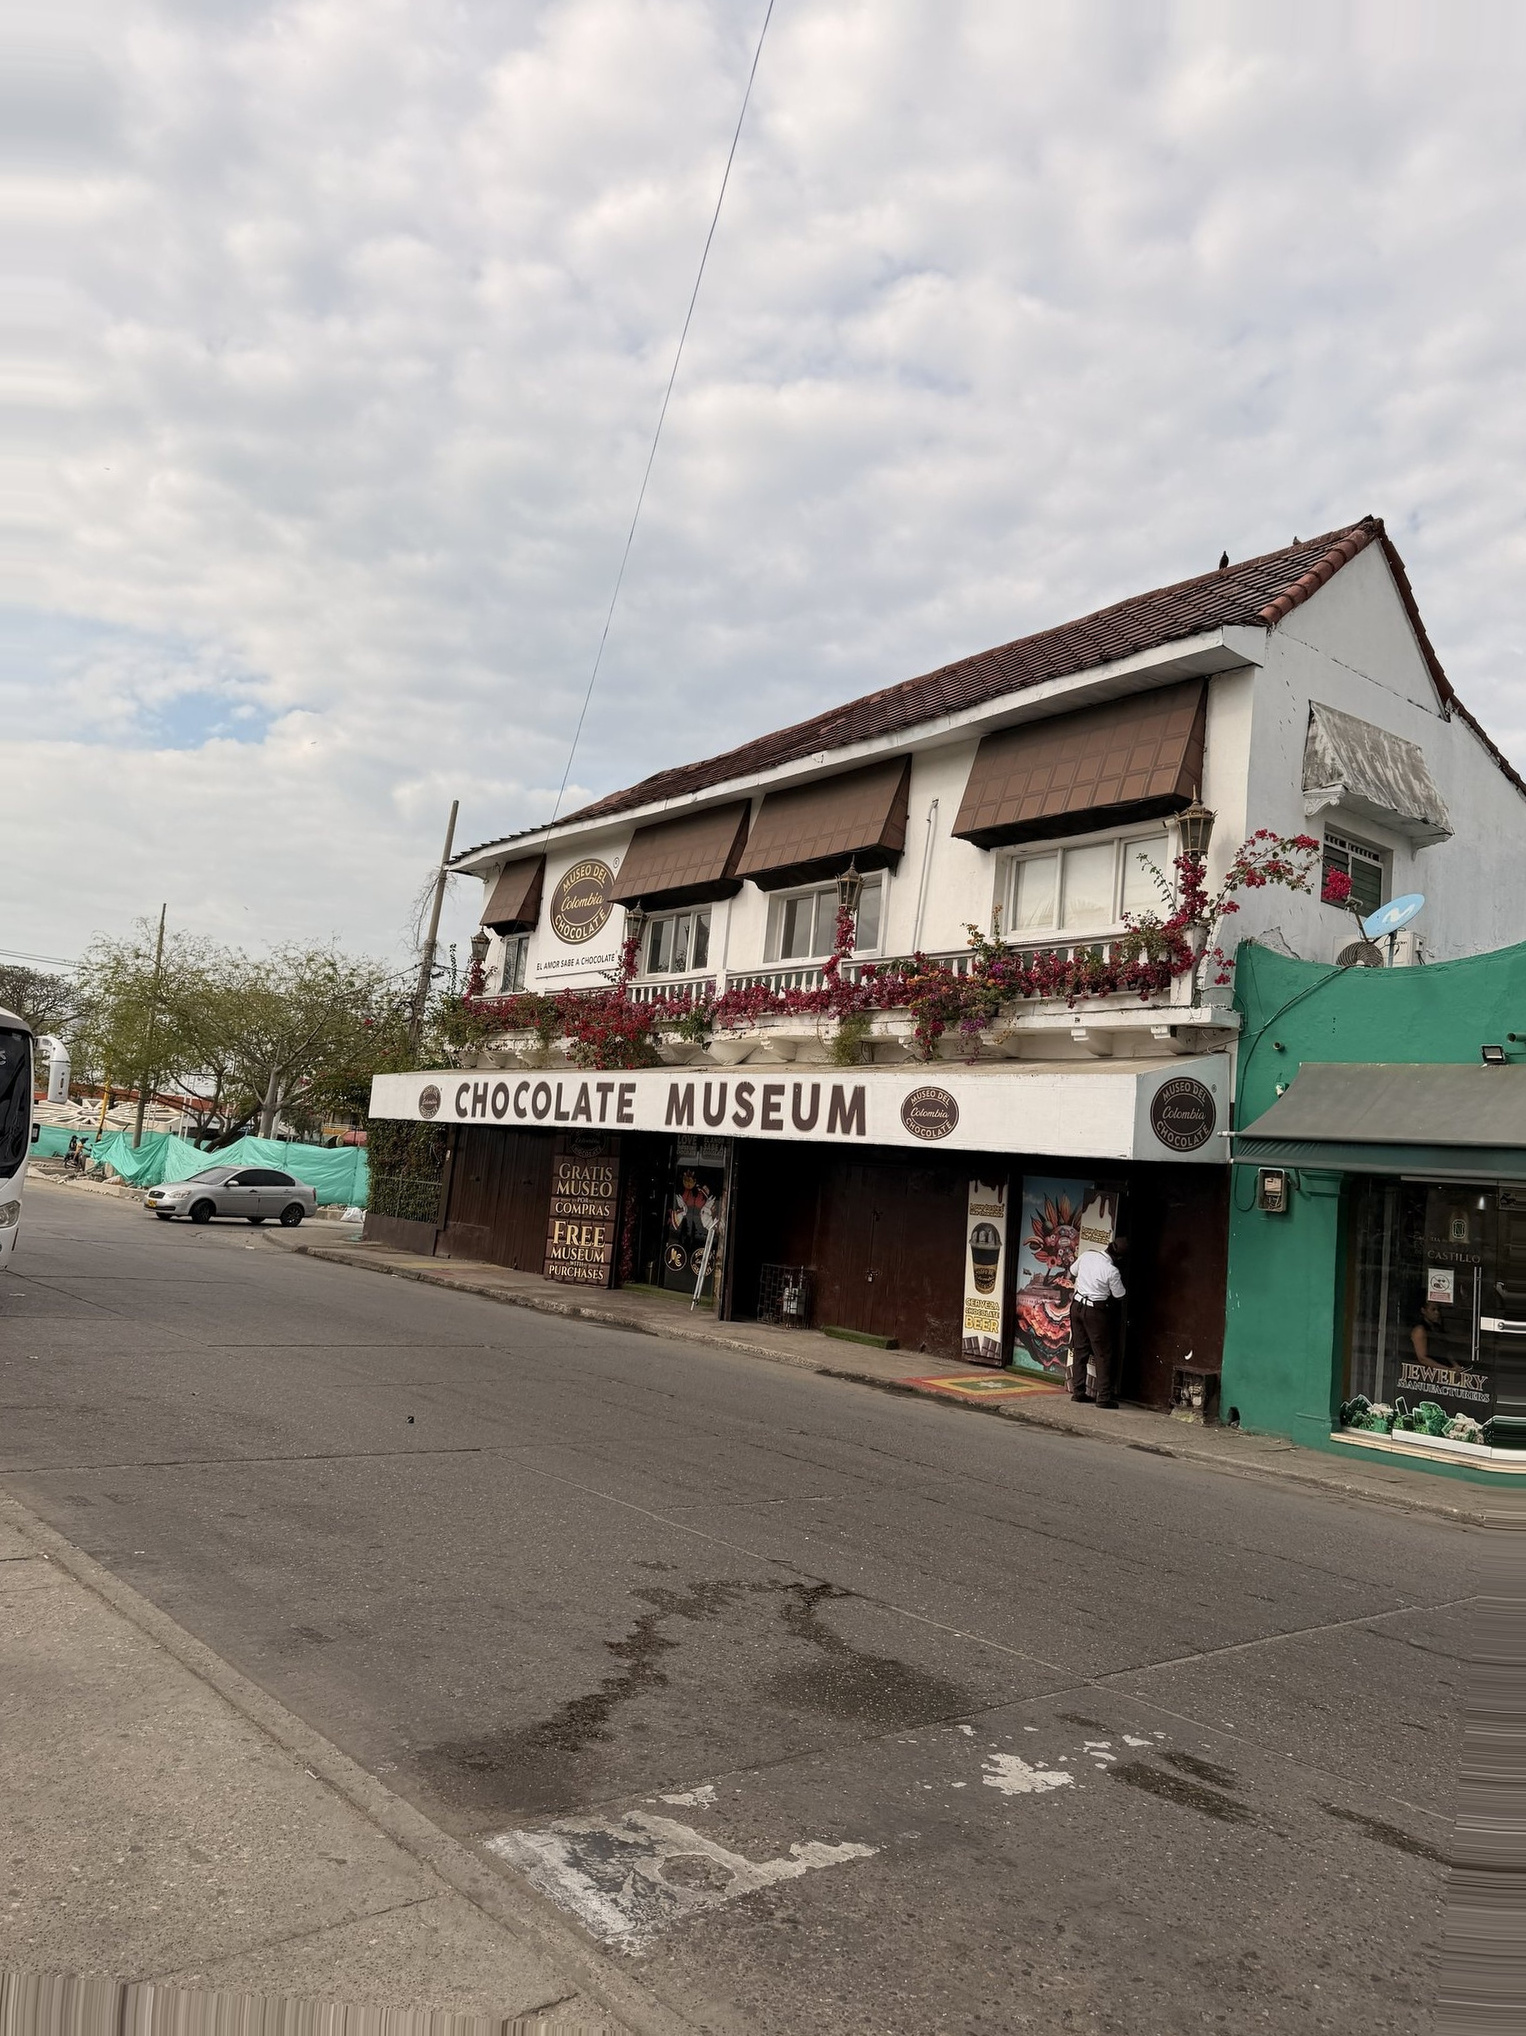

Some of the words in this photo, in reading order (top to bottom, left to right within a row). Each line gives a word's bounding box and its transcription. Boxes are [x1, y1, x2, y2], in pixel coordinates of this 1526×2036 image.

[563, 864, 592, 892] MUSEO
[593, 865, 608, 884] DEL
[560, 892, 604, 912] Colombia
[555, 909, 607, 939] CHOCOLATE
[536, 962, 543, 971] EL
[544, 960, 560, 969] AMOR
[560, 958, 574, 968] SABE
[575, 958, 581, 966] A
[581, 953, 616, 966] CHOCOLATE
[910, 1090, 936, 1105] MUSEO
[937, 1092, 951, 1106] DEL
[1162, 1082, 1191, 1101] MUSEO
[1192, 1083, 1208, 1102] DEL
[454, 1080, 637, 1124] CHOCOLATE
[664, 1081, 867, 1137] MUSEUM
[910, 1107, 950, 1118] Colombia
[1162, 1105, 1207, 1120] Colombia
[906, 1117, 952, 1137] CHOCOLATE
[1156, 1120, 1210, 1147] CHOCOLATE
[559, 1162, 613, 1181] GRATIS
[556, 1180, 613, 1198] MUSEO
[555, 1201, 610, 1217] COMPRAS
[552, 1220, 606, 1248] FREE
[550, 1246, 605, 1264] MUSEUM
[1427, 1249, 1481, 1264] CASTILLO
[548, 1264, 604, 1280] PURCHASES
[965, 1297, 1000, 1311] CERVEZA
[965, 1307, 1000, 1319] CHOCOLATE
[965, 1315, 999, 1334] BEER
[1400, 1362, 1489, 1392] JEWELRY
[1396, 1378, 1491, 1403] MANUFACTURERS
